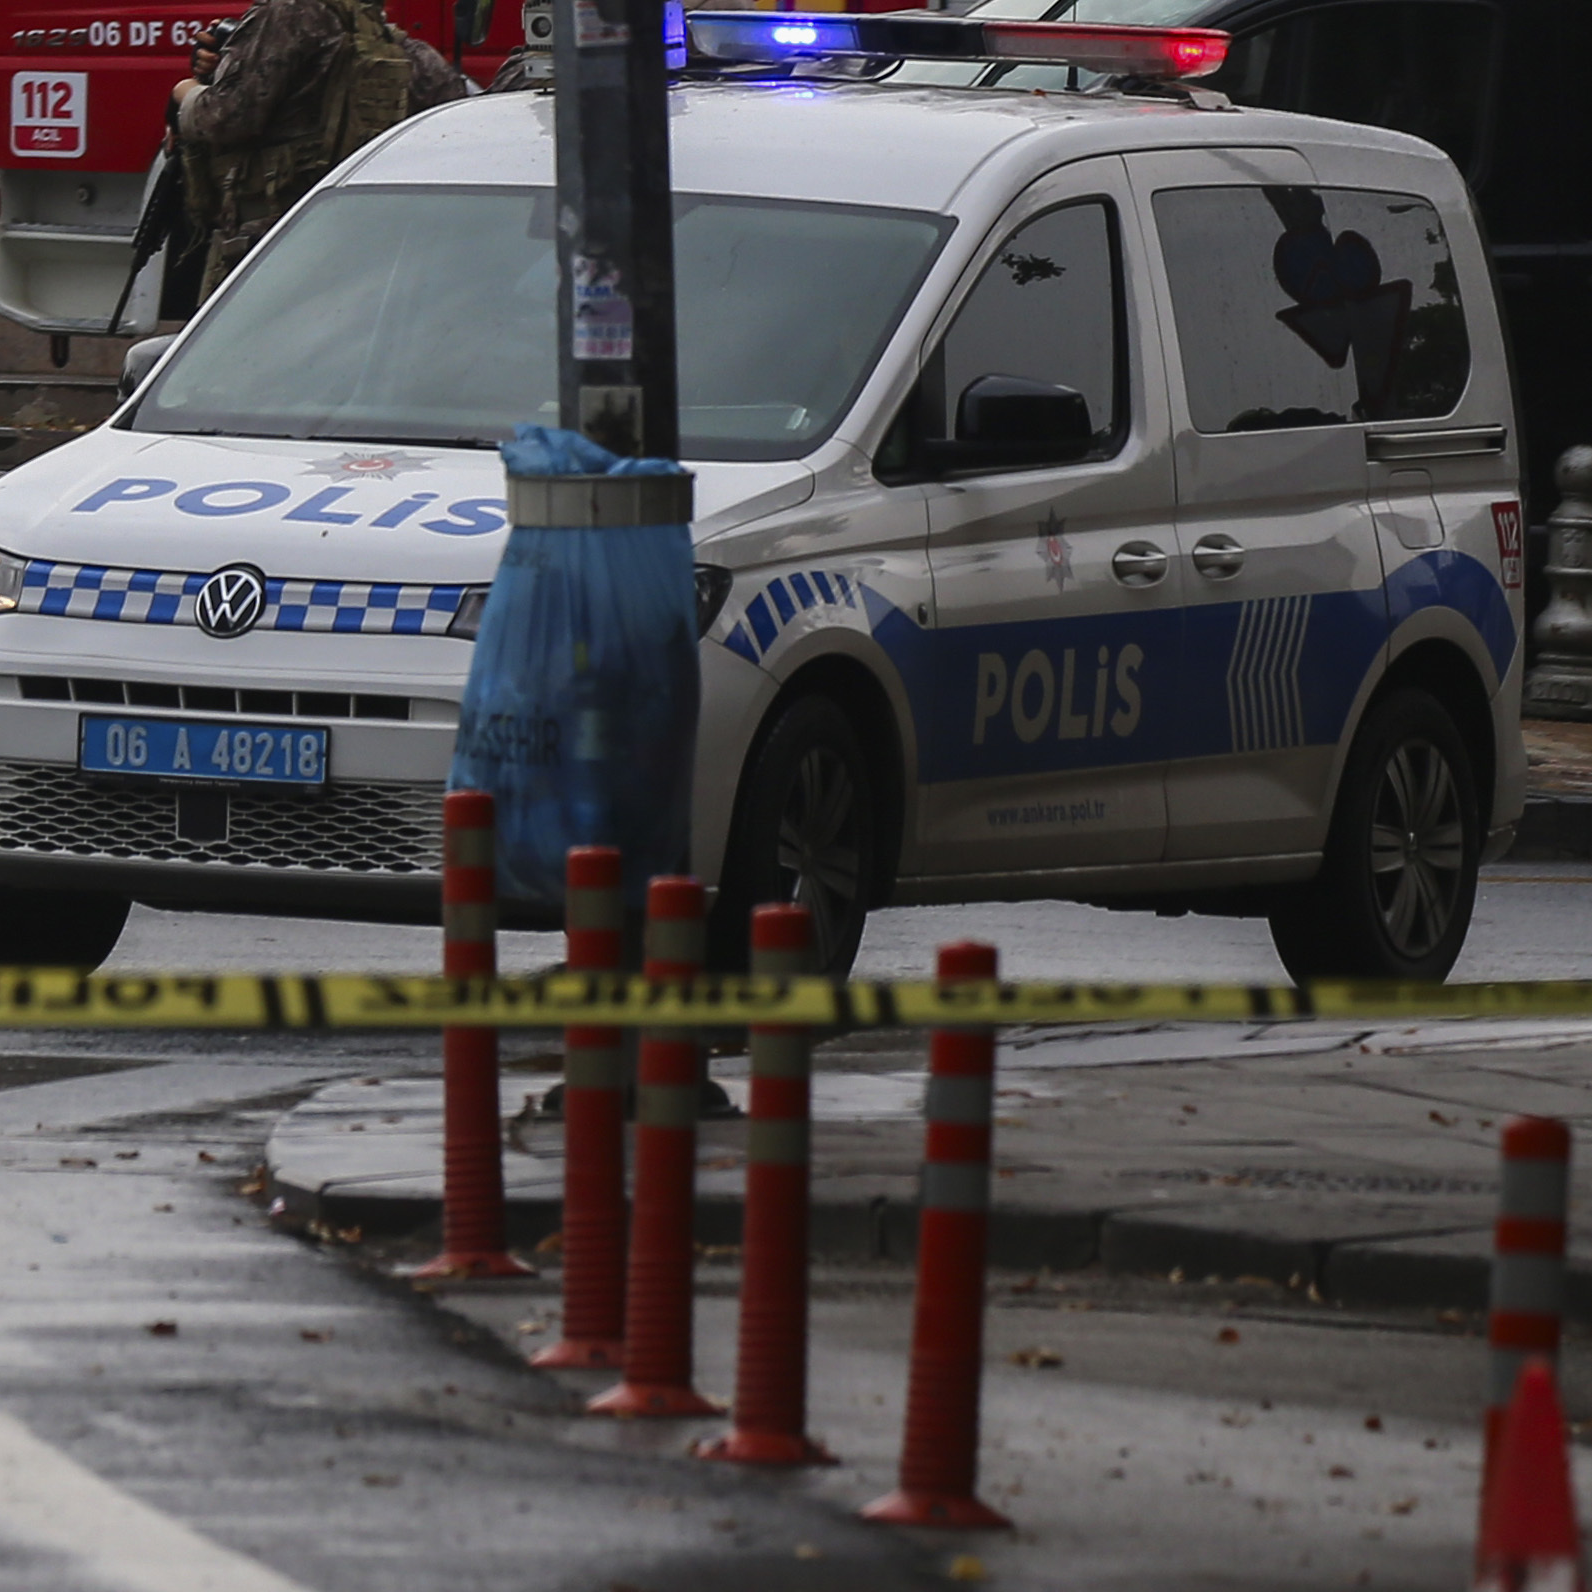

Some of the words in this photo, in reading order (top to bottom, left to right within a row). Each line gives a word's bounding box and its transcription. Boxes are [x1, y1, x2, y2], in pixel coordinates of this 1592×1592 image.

[89, 21, 121, 47] 06
[129, 21, 163, 47] DF
[22, 80, 73, 119] 112
[72, 477, 506, 537] POLİS
[1498, 512, 1519, 550] 112
[973, 643, 1144, 745] POLİS
[106, 723, 148, 767] 06
[172, 727, 192, 771] A
[211, 729, 319, 777] 48218
